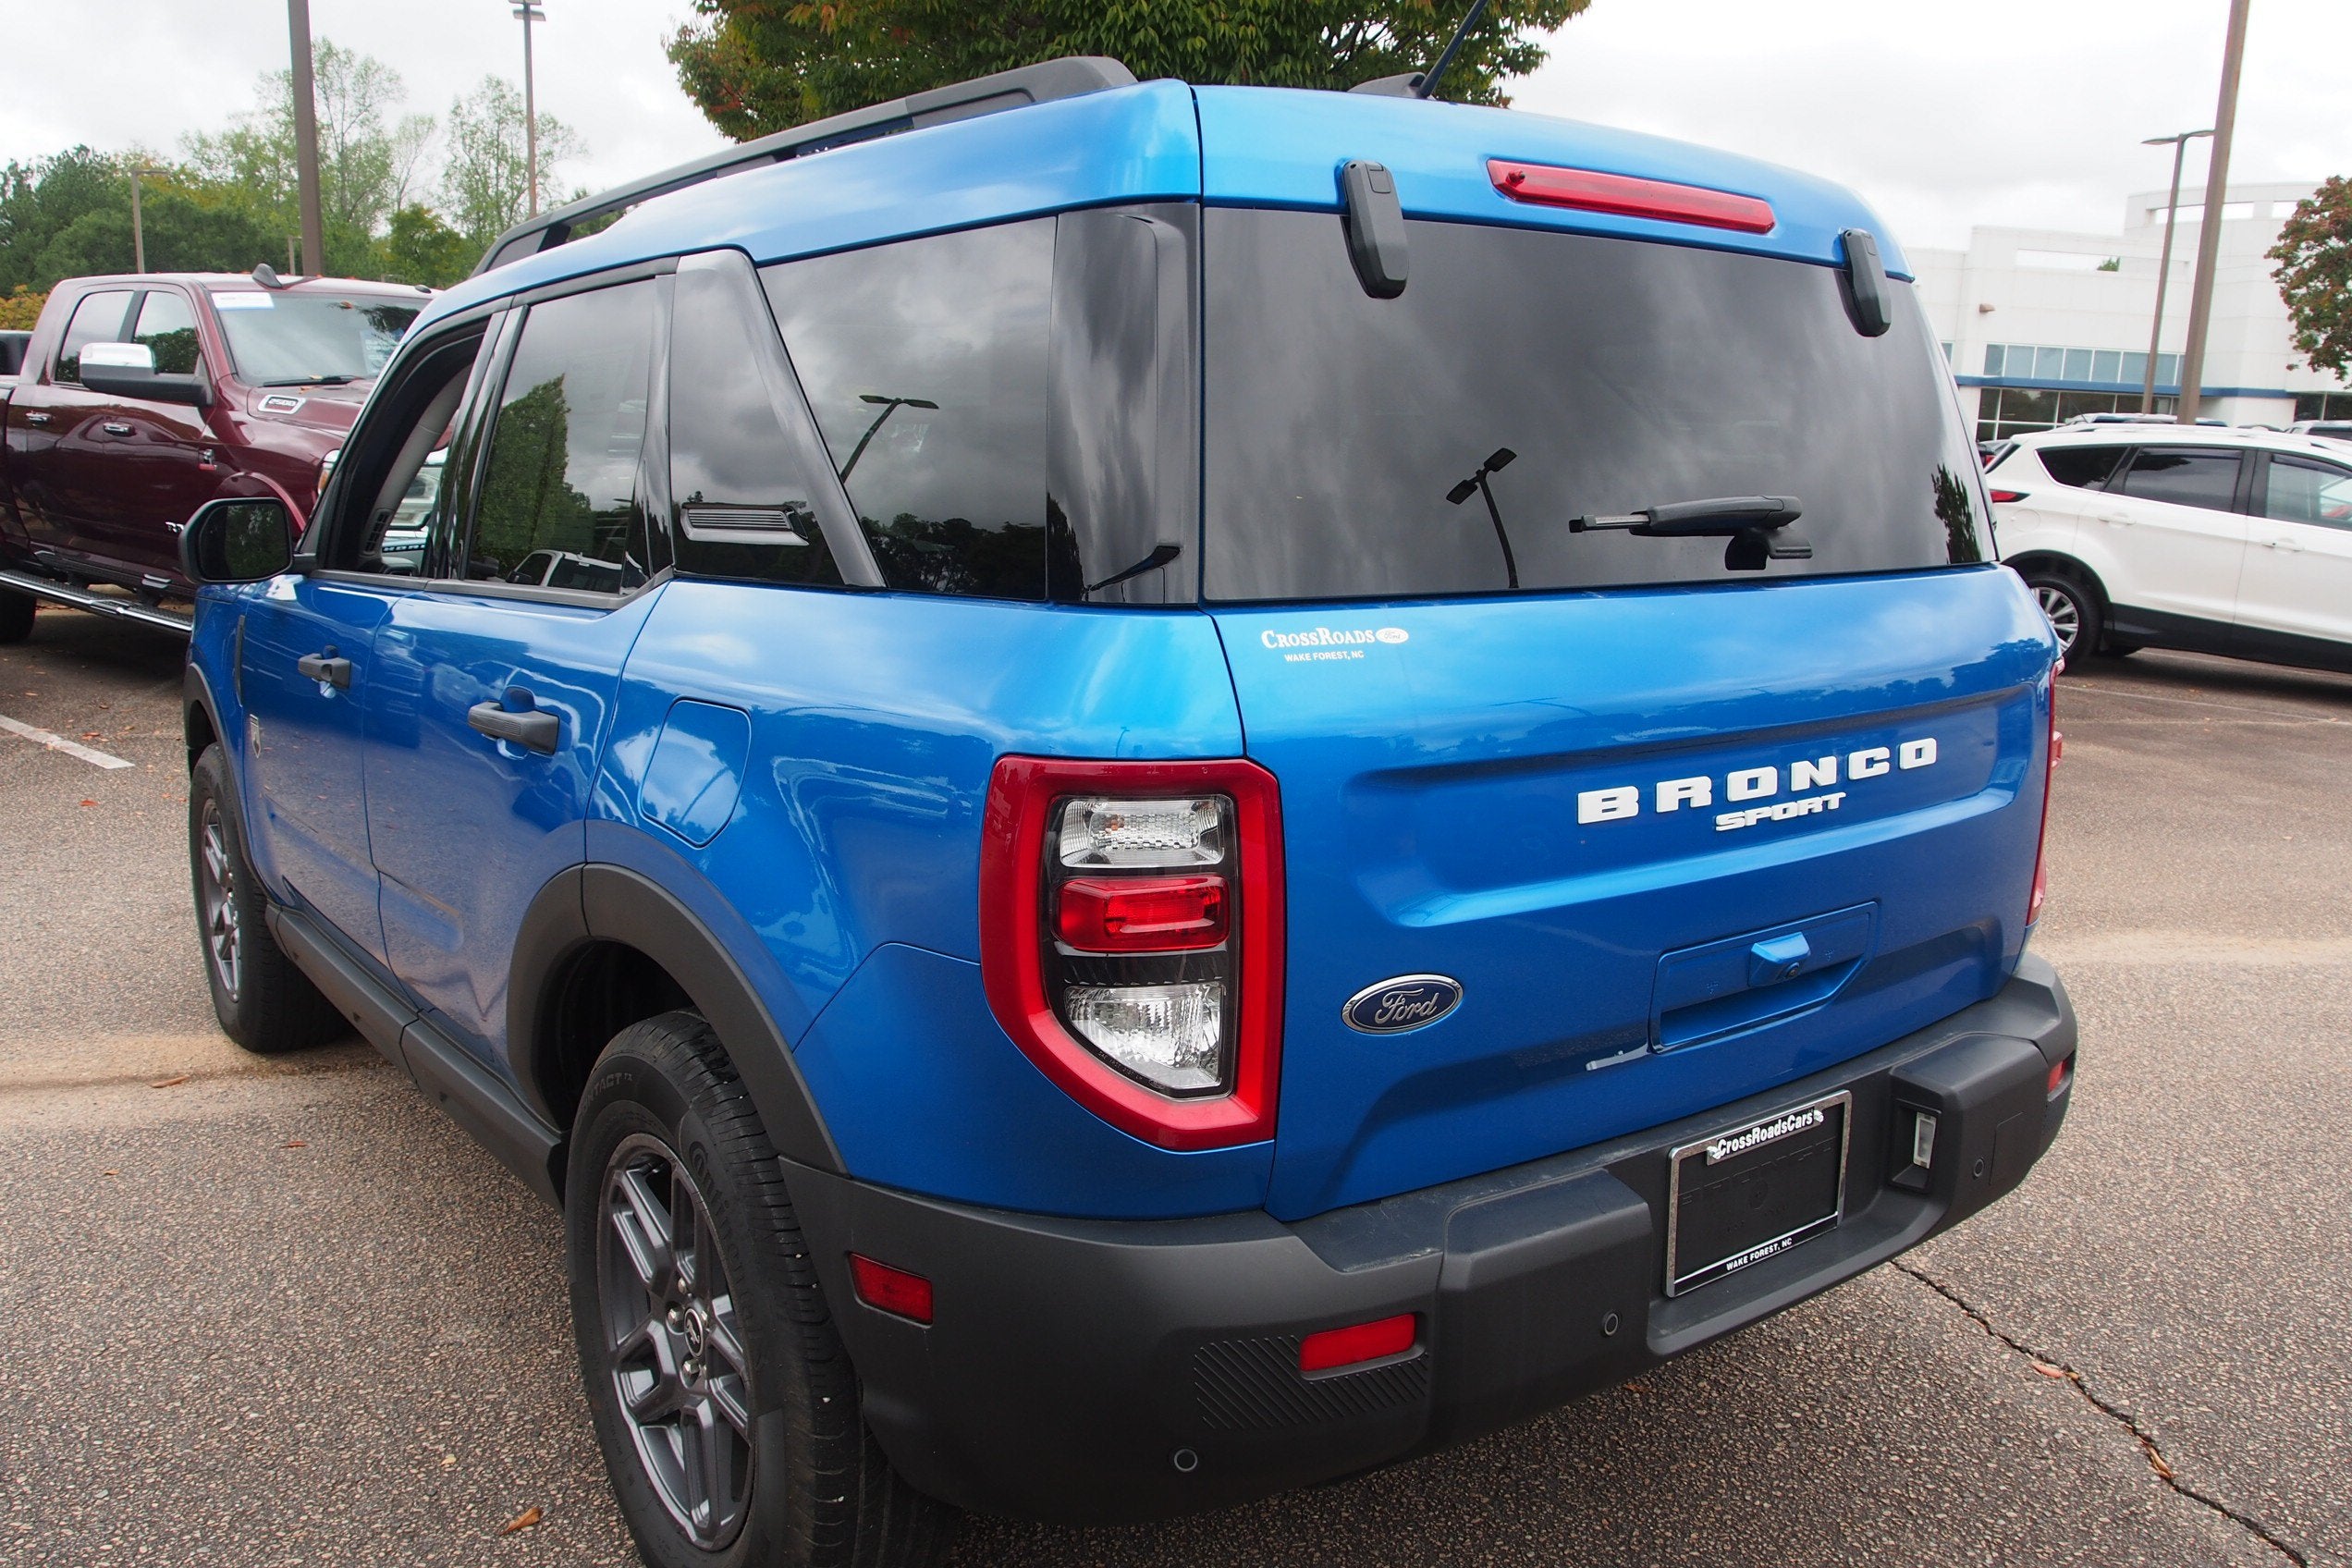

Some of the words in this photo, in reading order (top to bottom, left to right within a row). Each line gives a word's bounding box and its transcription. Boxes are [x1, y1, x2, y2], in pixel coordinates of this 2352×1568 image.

[1284, 652, 1312, 662] WAKE
[1313, 650, 1351, 661] FOREST,
[1352, 650, 1365, 659] NC
[1576, 737, 1938, 825] BRONCO
[1715, 790, 1847, 832] SPORT
[1375, 987, 1439, 1024] Ford
[1717, 1110, 1813, 1155] CrossRoadsCars
[1726, 1256, 1748, 1271] WAKE
[1749, 1244, 1781, 1263] FOREST,
[1781, 1237, 1793, 1250] NC
